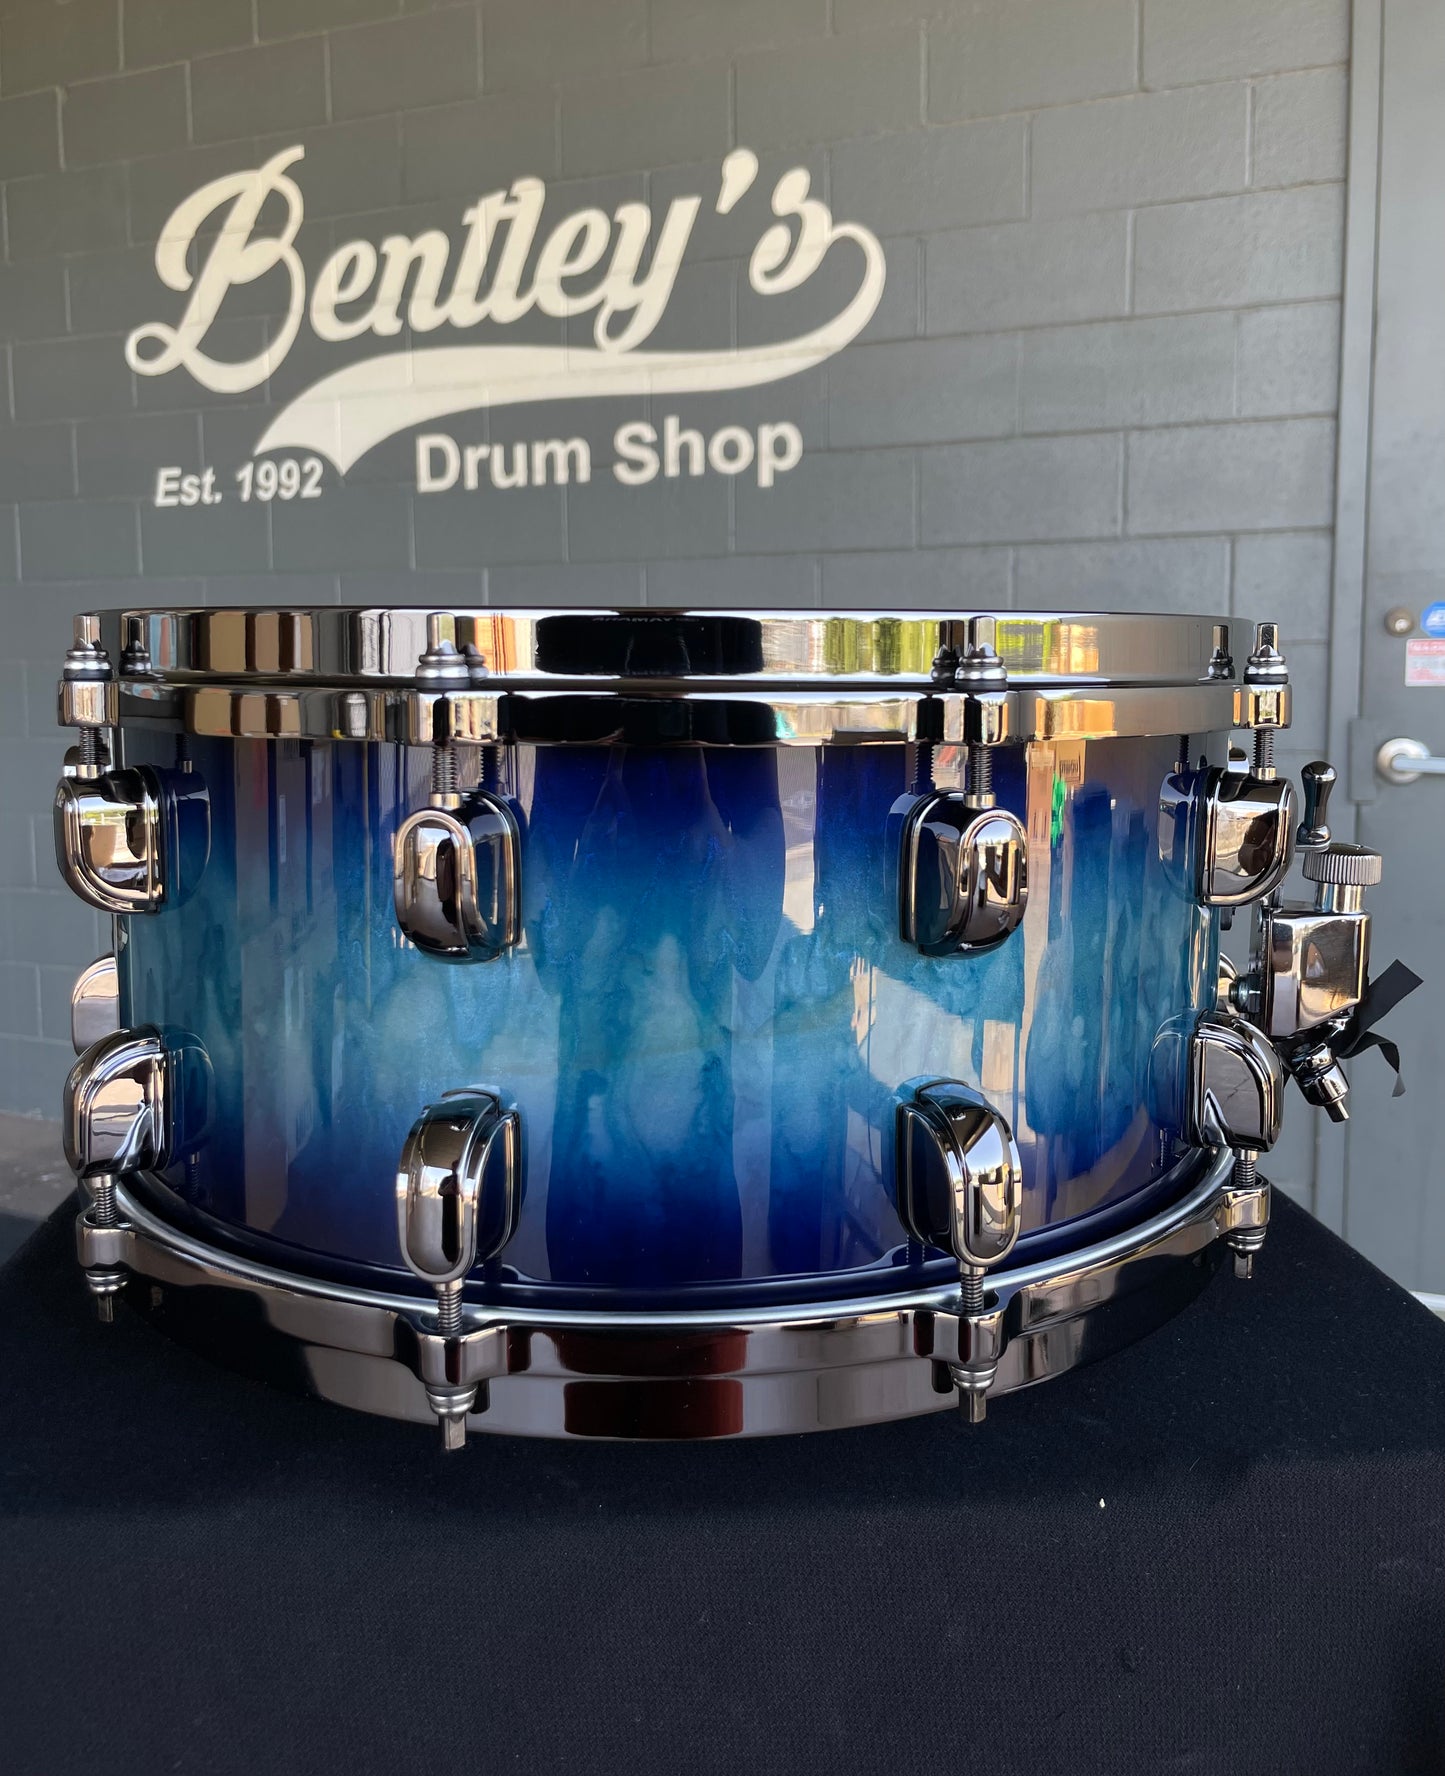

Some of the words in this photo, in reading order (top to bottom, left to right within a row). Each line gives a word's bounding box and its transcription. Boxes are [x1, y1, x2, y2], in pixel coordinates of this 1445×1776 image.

[124, 144, 885, 393] Bentley's
[154, 466, 222, 507] Est.
[236, 457, 323, 502] 1992
[415, 433, 591, 494] Drum
[612, 415, 803, 488] Shop
